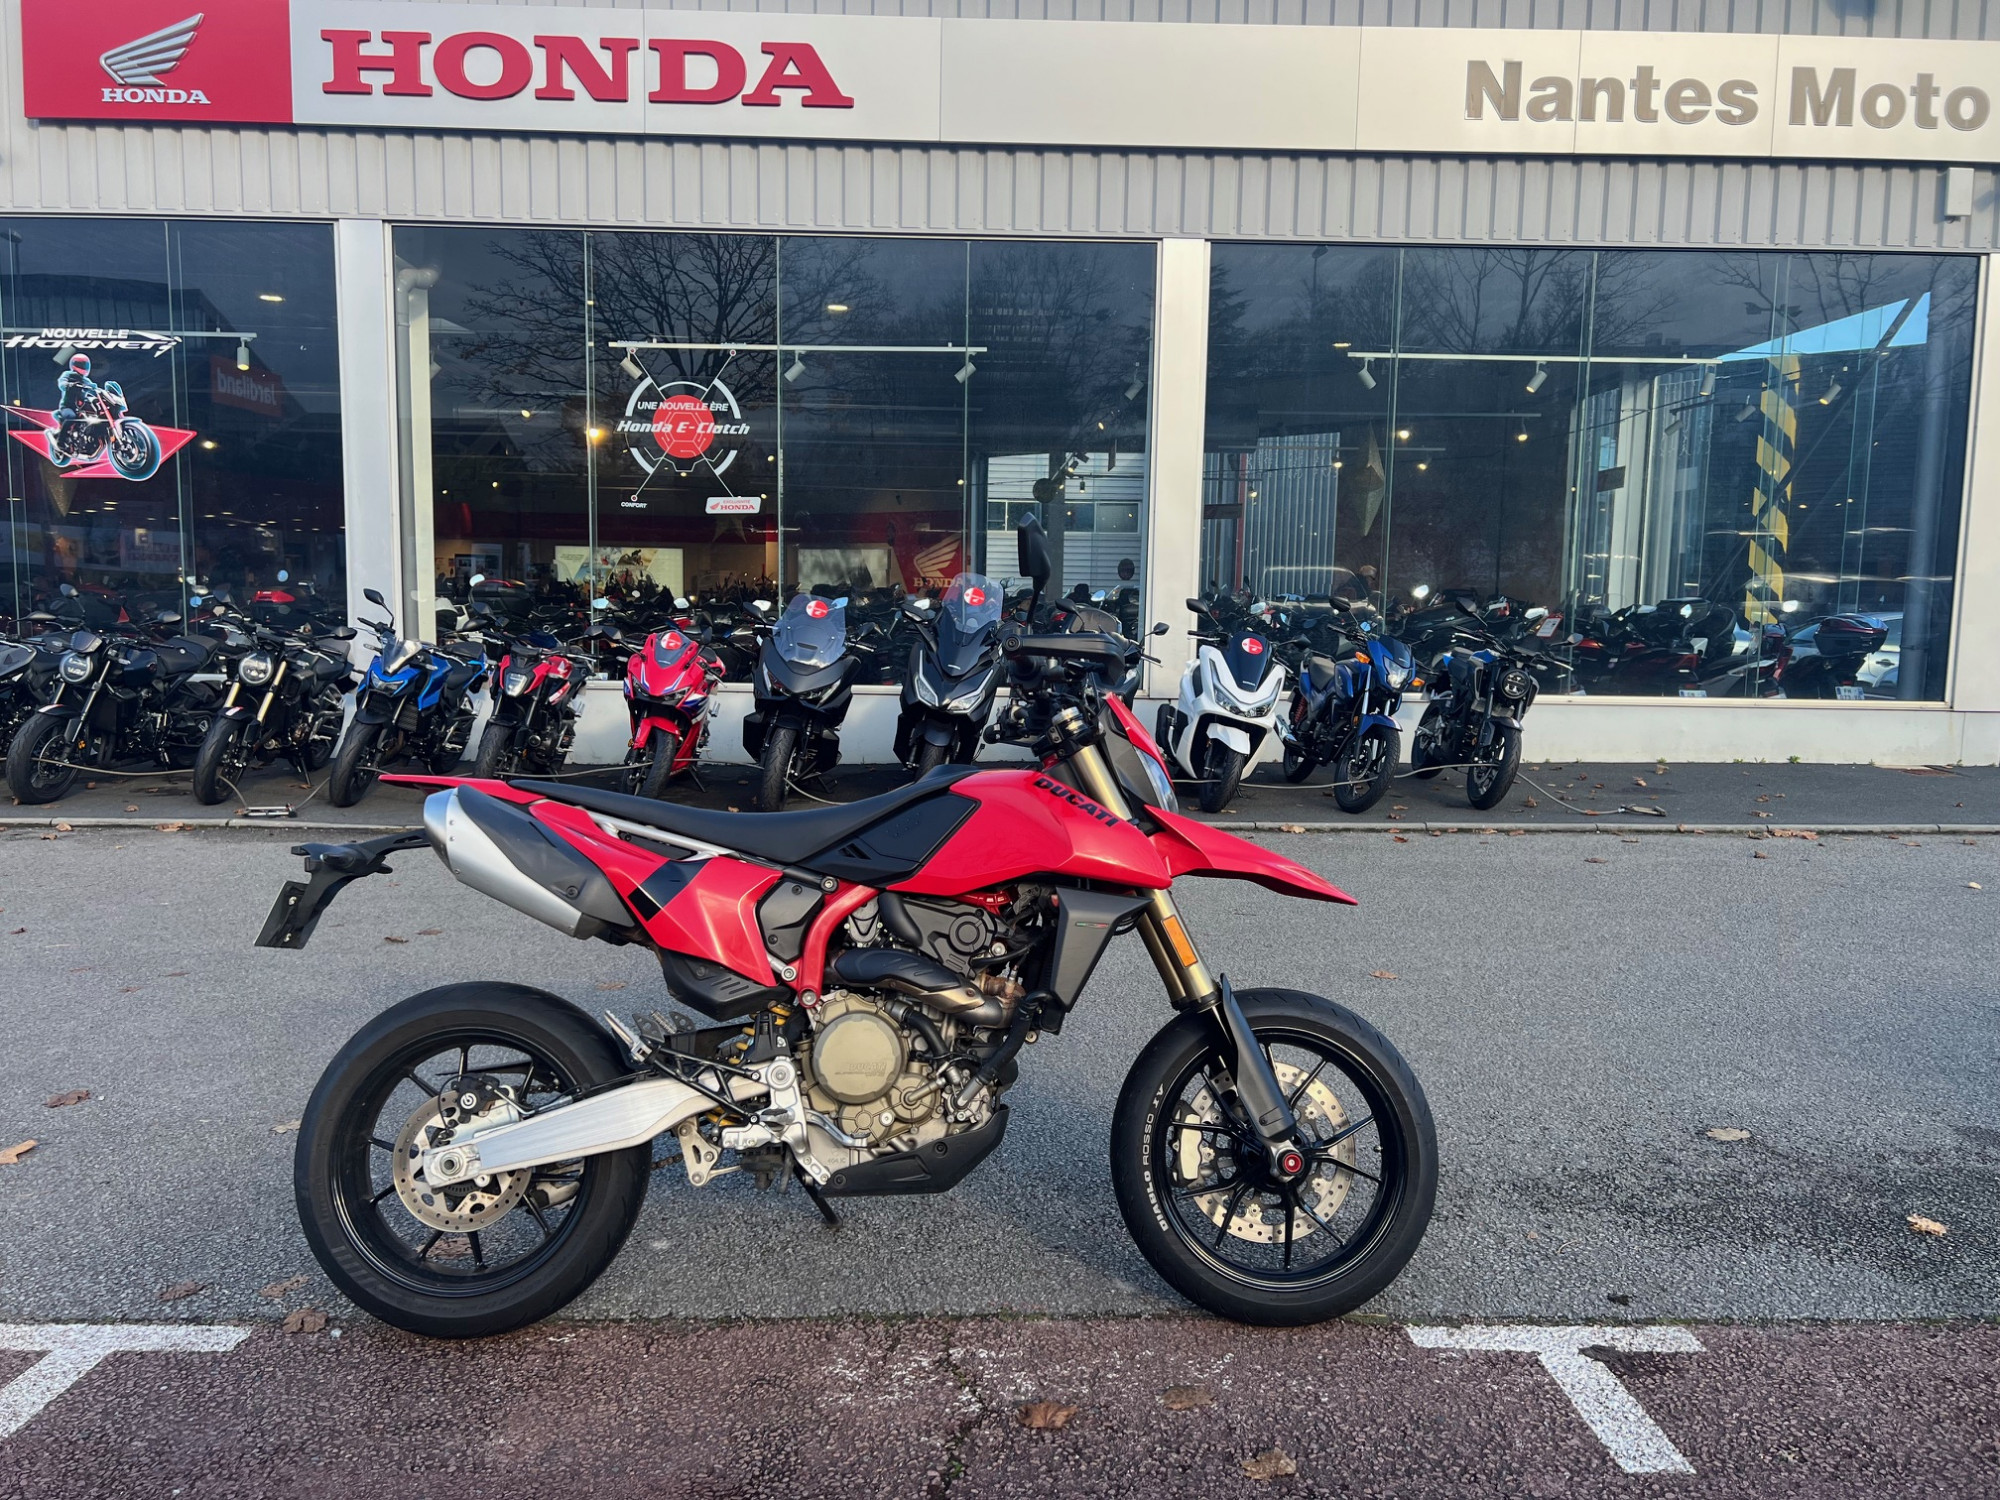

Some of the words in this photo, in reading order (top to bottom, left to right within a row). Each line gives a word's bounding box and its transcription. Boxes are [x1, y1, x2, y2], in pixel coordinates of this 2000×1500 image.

[320, 28, 855, 109] HONDA
[101, 87, 211, 105] HONDA
[1463, 59, 1759, 126] Nantes
[1788, 66, 1991, 131] Moto
[41, 328, 129, 339] NOUVELLE
[3, 335, 171, 350] HORNET
[637, 401, 658, 410] UNE
[659, 402, 709, 411] NOUVELLE
[710, 400, 729, 412] ÈRE
[616, 420, 673, 433] Honda
[676, 421, 751, 435] E-Clutch
[620, 501, 648, 509] CONFORT
[913, 577, 965, 588] HONDA
[1033, 777, 1120, 827] DUCATI
[1142, 1113, 1154, 1166] ROSSO
[1144, 1170, 1169, 1232] DIABLO
